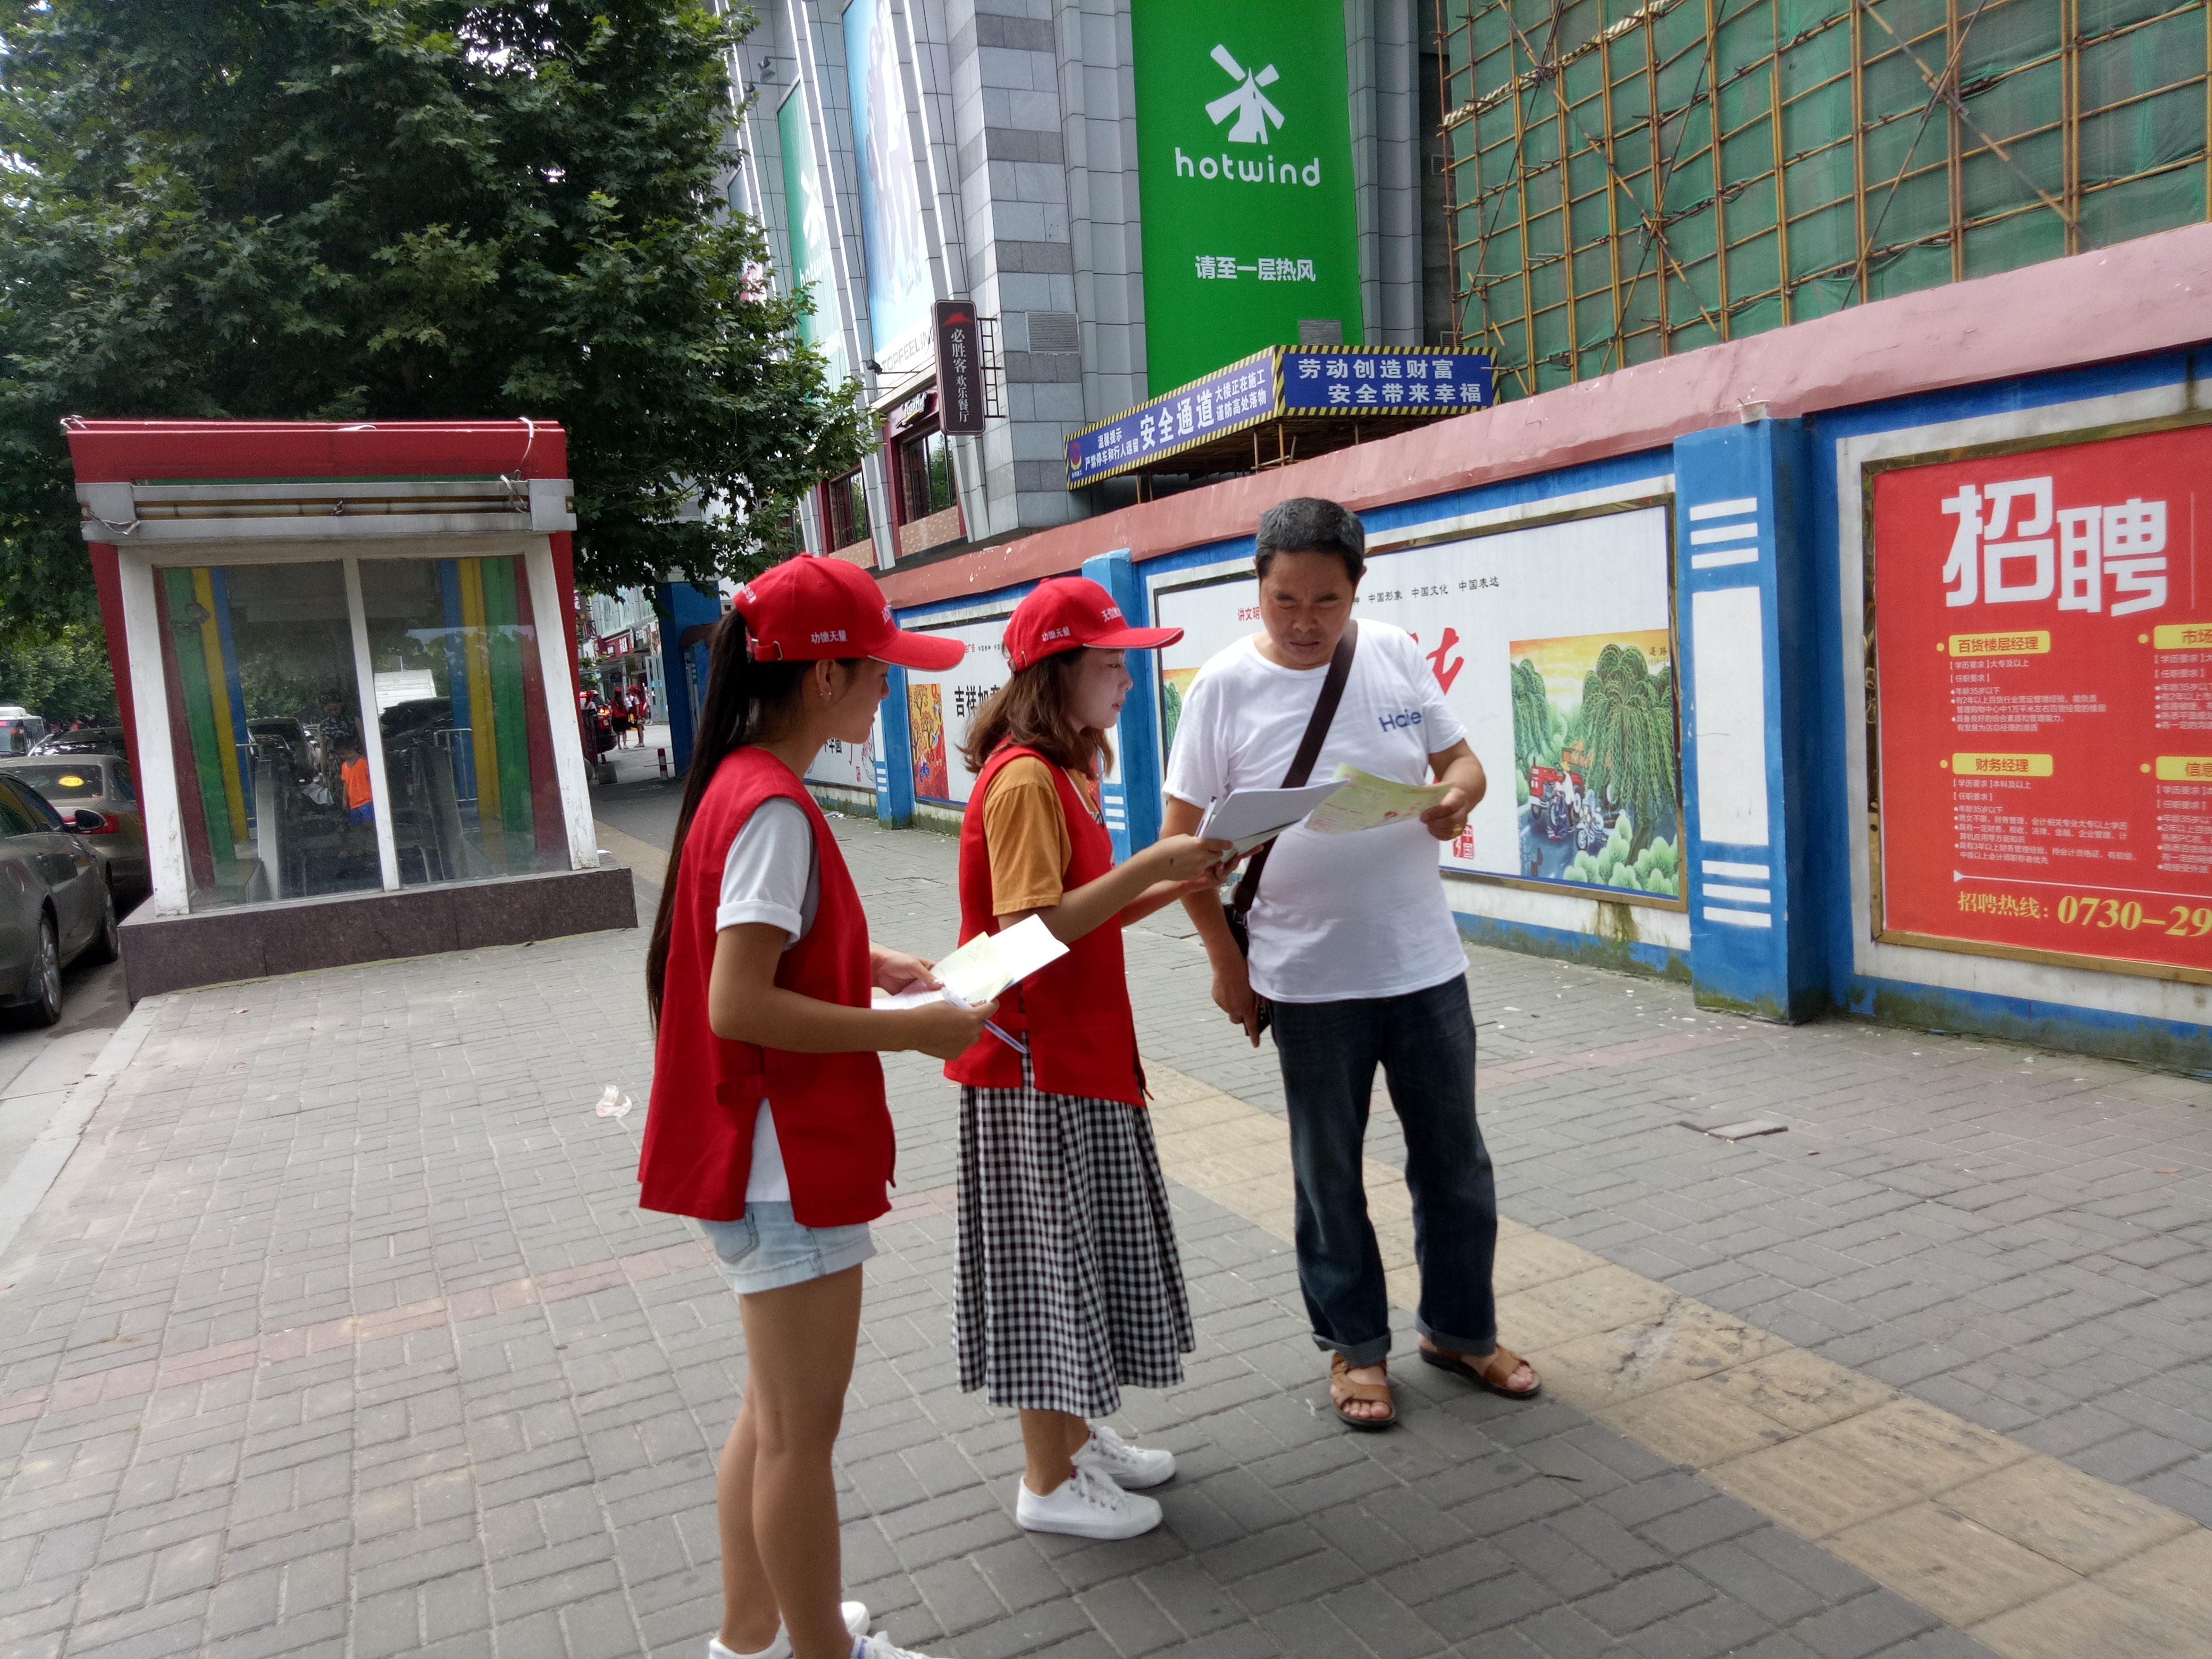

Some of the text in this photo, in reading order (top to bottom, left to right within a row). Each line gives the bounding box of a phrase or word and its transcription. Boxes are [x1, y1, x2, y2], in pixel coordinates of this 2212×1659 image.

[1175, 147, 1320, 187] hotwind
[1195, 255, 1316, 282] 请至一层热风
[951, 328, 969, 423] 必胜客 欢乐餐厅
[1298, 358, 1453, 379] 劳动创造财富
[1215, 368, 1266, 403] 大楼正在施工
[1328, 383, 1481, 404] 安全带来幸福
[1216, 389, 1267, 422] 谨防高处落物
[1140, 389, 1214, 451] 安全通道
[1097, 428, 1122, 449] 温馨提示
[1085, 438, 1139, 471] 严禁停车和行人逗留
[1941, 476, 2167, 617] 招聘
[1368, 590, 1402, 603] 中国形象
[1412, 584, 1448, 598] 中国文化
[1459, 576, 1499, 592] 中国表达
[810, 630, 848, 644] 功德无量
[1041, 626, 1071, 642] 功德无量
[1958, 636, 2039, 653] 百货楼层经理
[954, 684, 1000, 718] 吉祥如
[1975, 758, 2029, 773] 财务经理
